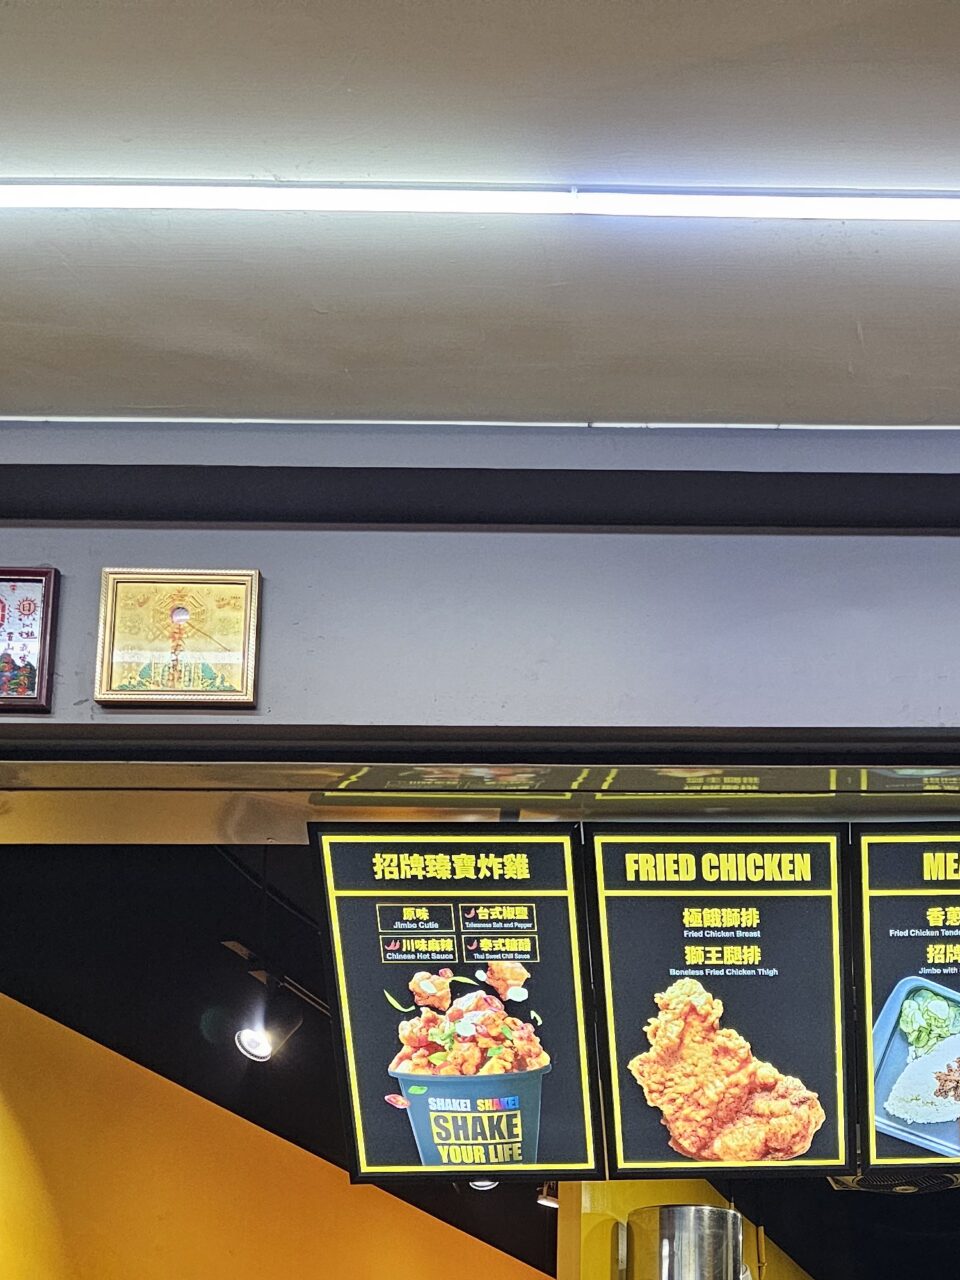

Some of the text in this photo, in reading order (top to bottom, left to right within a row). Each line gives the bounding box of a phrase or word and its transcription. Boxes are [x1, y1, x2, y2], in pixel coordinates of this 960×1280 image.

[373, 853, 530, 880] 招牌臻寶炸雞
[625, 853, 812, 882] FRIED CHICKEN
[402, 907, 429, 921] 原味
[476, 906, 529, 920] 台式椒鹽
[393, 921, 439, 929] Jimbo Cutie
[683, 930, 761, 938] Fried Chicken Breast
[889, 929, 909, 937] Fried
[909, 929, 939, 937] Chicken
[402, 939, 454, 951] 川味麻辣
[386, 952, 454, 960] Chinese Hot Sauce
[684, 946, 762, 965] 獅王腿排
[669, 968, 778, 977] Boneless Fried Chicken Thigh
[942, 967, 958, 975] with
[428, 1096, 519, 1111] SHAKE! SHAKE!
[434, 1113, 520, 1141] SHAKE
[437, 1143, 522, 1164] YOUR LIFE
